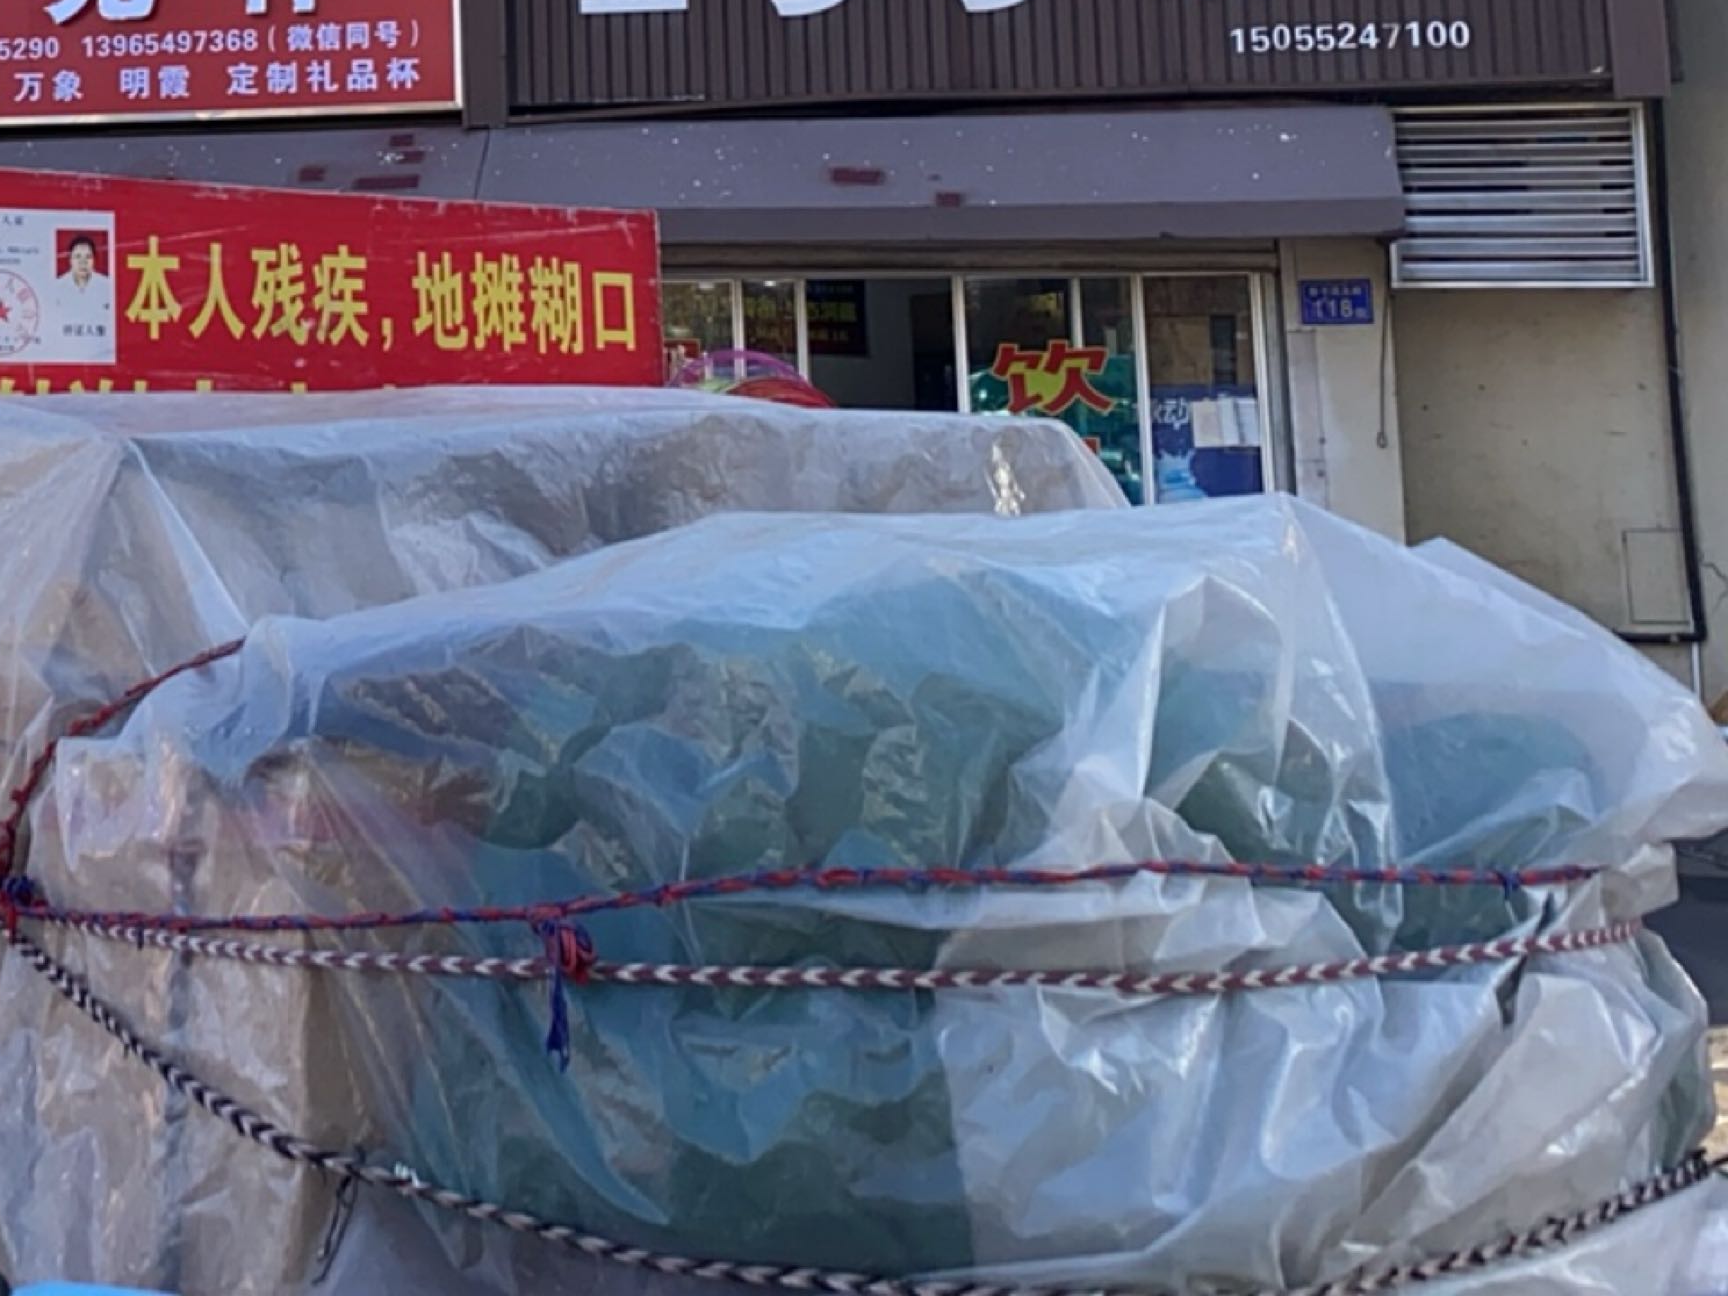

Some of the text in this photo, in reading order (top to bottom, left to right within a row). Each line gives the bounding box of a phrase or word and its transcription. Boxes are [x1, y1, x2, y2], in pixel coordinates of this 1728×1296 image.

[1229, 20, 1471, 54] 15055247100
[13, 68, 84, 102] 万象
[226, 55, 423, 96] 定制礼品杯
[125, 234, 638, 355] 本人残疾，地摊糊口
[991, 337, 1115, 415] 饮
